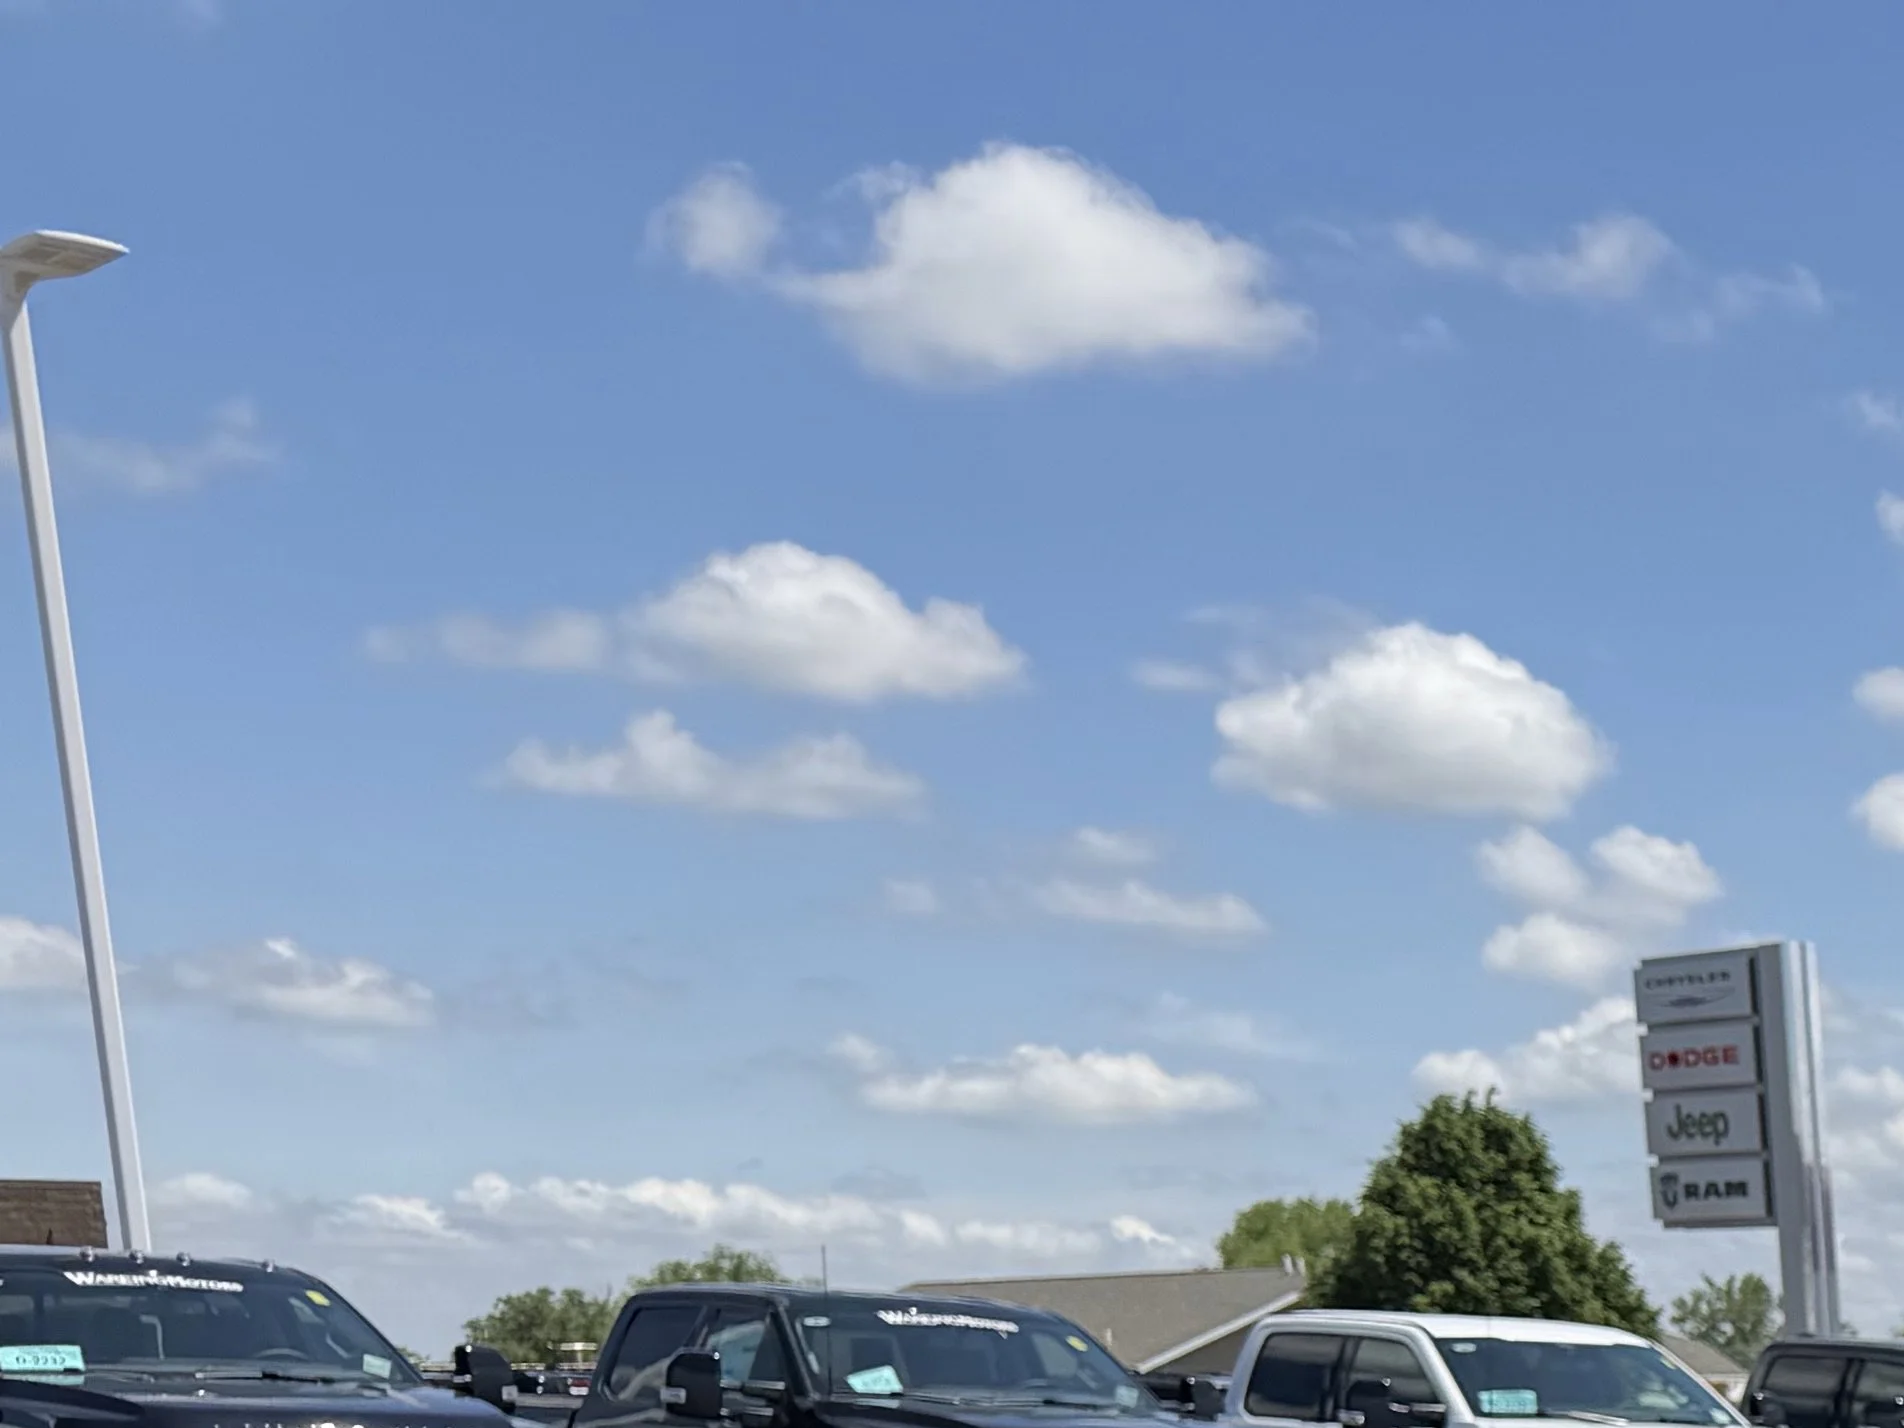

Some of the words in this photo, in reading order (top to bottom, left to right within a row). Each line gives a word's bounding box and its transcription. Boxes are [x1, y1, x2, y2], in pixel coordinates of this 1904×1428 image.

[1648, 1045, 1740, 1071] DODGE
[1666, 1104, 1730, 1145] Jeep
[1684, 1180, 1749, 1200] RAM
